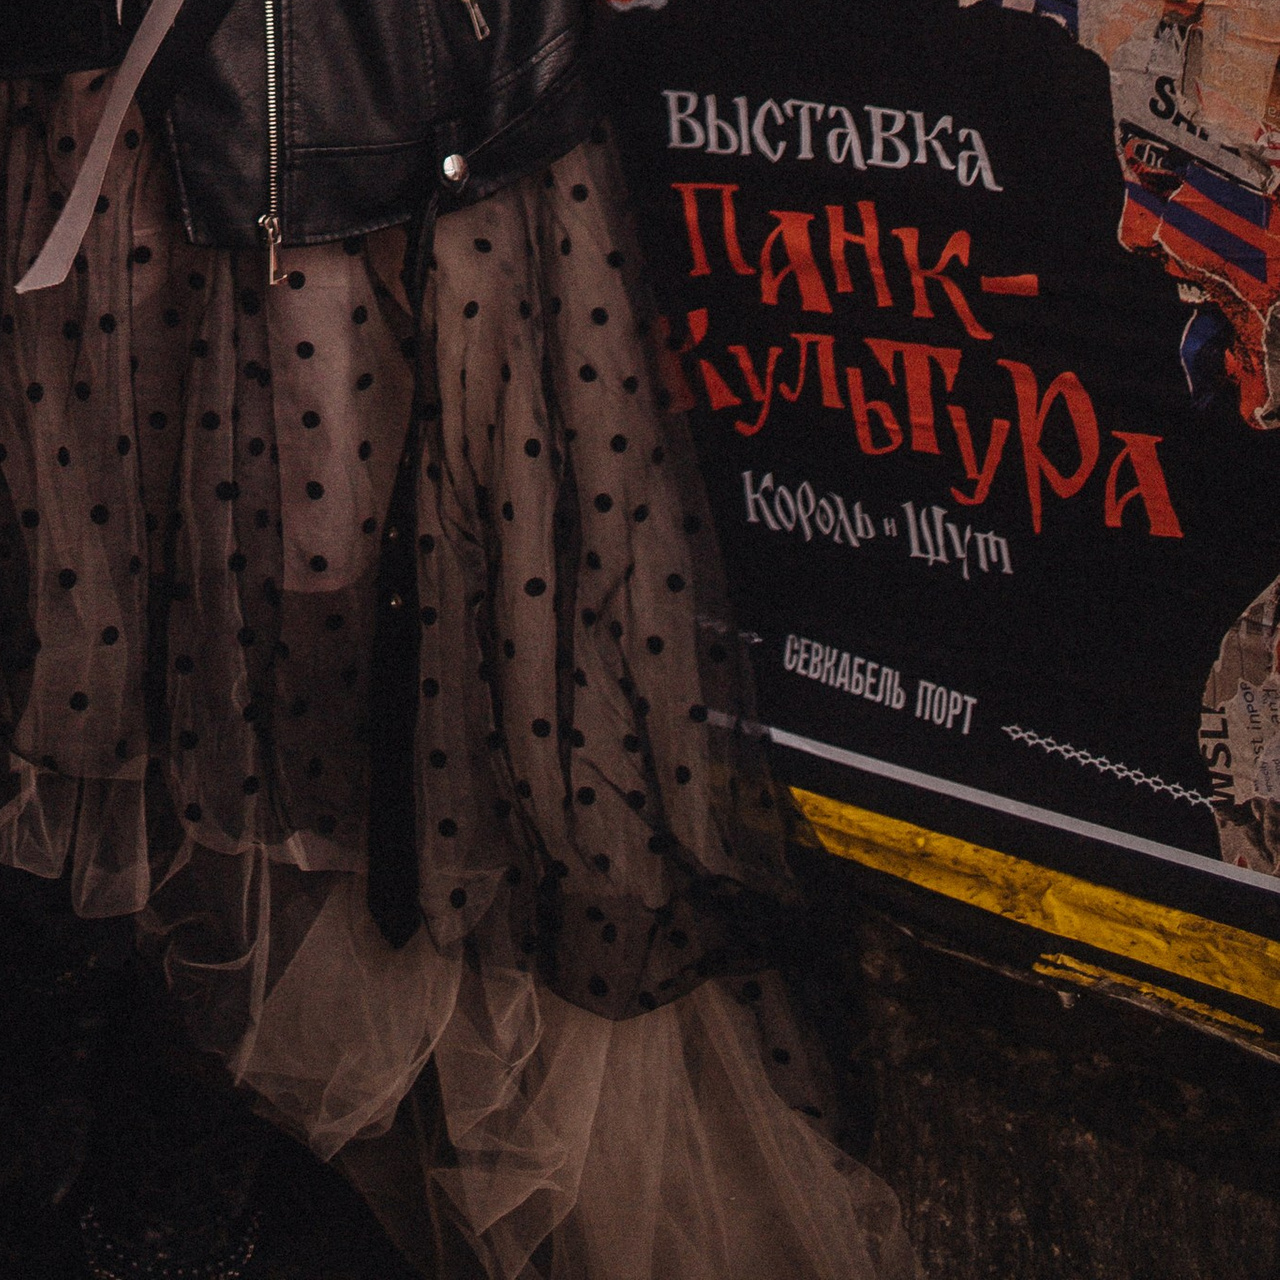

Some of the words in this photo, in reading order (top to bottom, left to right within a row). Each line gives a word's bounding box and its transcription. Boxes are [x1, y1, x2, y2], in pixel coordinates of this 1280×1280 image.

[660, 89, 1005, 193] ВЫСТАВКА
[670, 182, 1040, 341] ПАНК-
[782, 633, 907, 712] СЕВКАБЕЛЬ
[915, 678, 978, 736] ПОРТ
